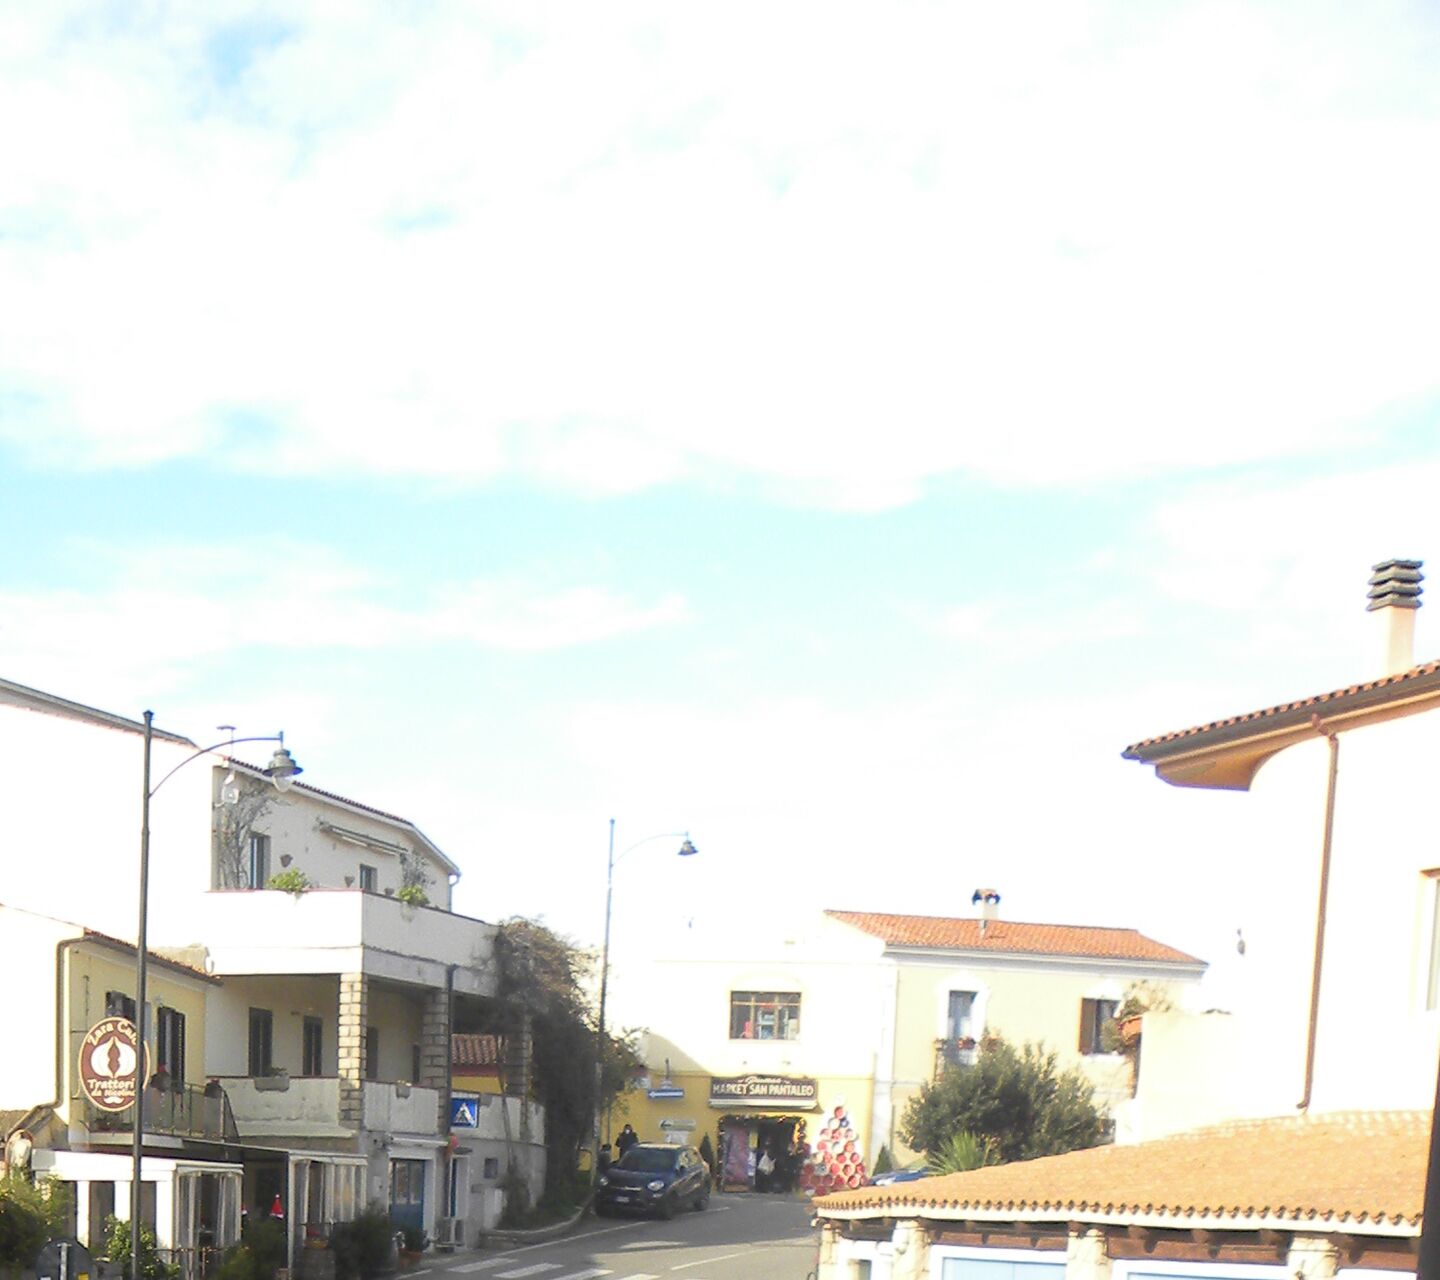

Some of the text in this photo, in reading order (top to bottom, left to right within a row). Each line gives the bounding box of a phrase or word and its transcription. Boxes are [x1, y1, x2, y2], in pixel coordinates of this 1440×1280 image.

[87, 1022, 114, 1046] Zara
[87, 1078, 136, 1090] Trattori
[712, 1083, 814, 1097] MARKET SAN PANTALEO
